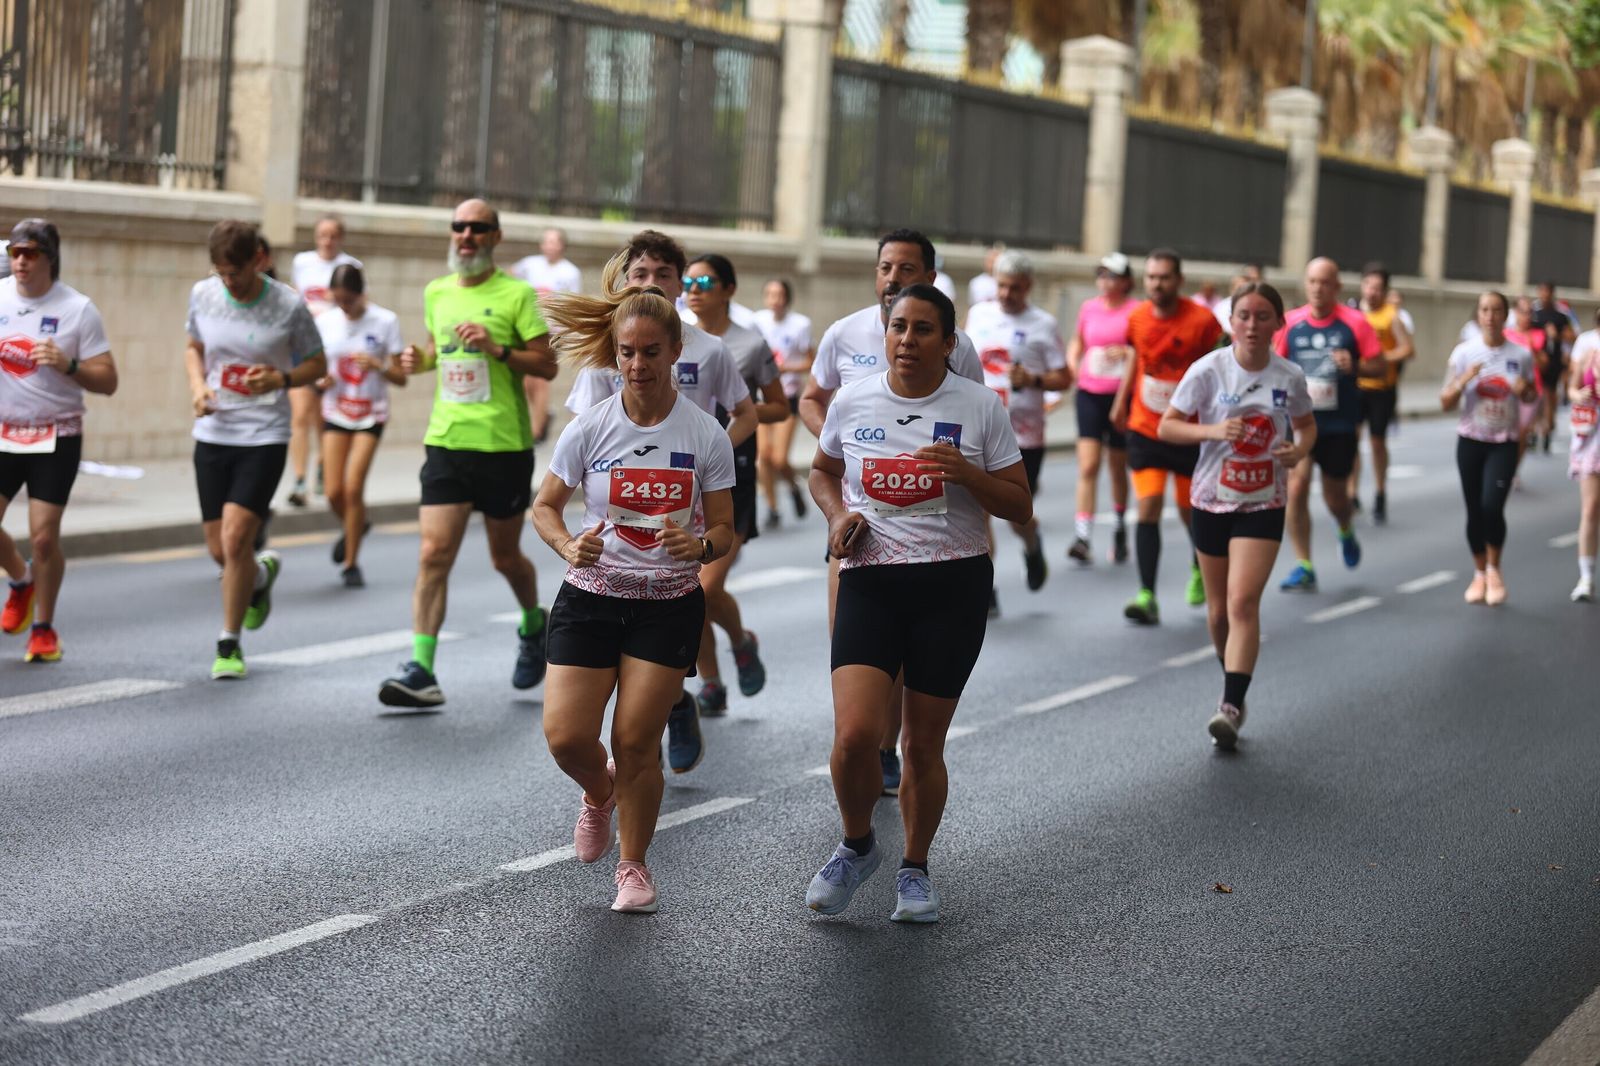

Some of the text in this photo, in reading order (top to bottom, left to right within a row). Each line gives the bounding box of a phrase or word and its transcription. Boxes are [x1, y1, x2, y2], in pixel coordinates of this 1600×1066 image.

[872, 473, 932, 490] 2020
[1226, 467, 1267, 482] 2417
[620, 481, 683, 499] 2432
